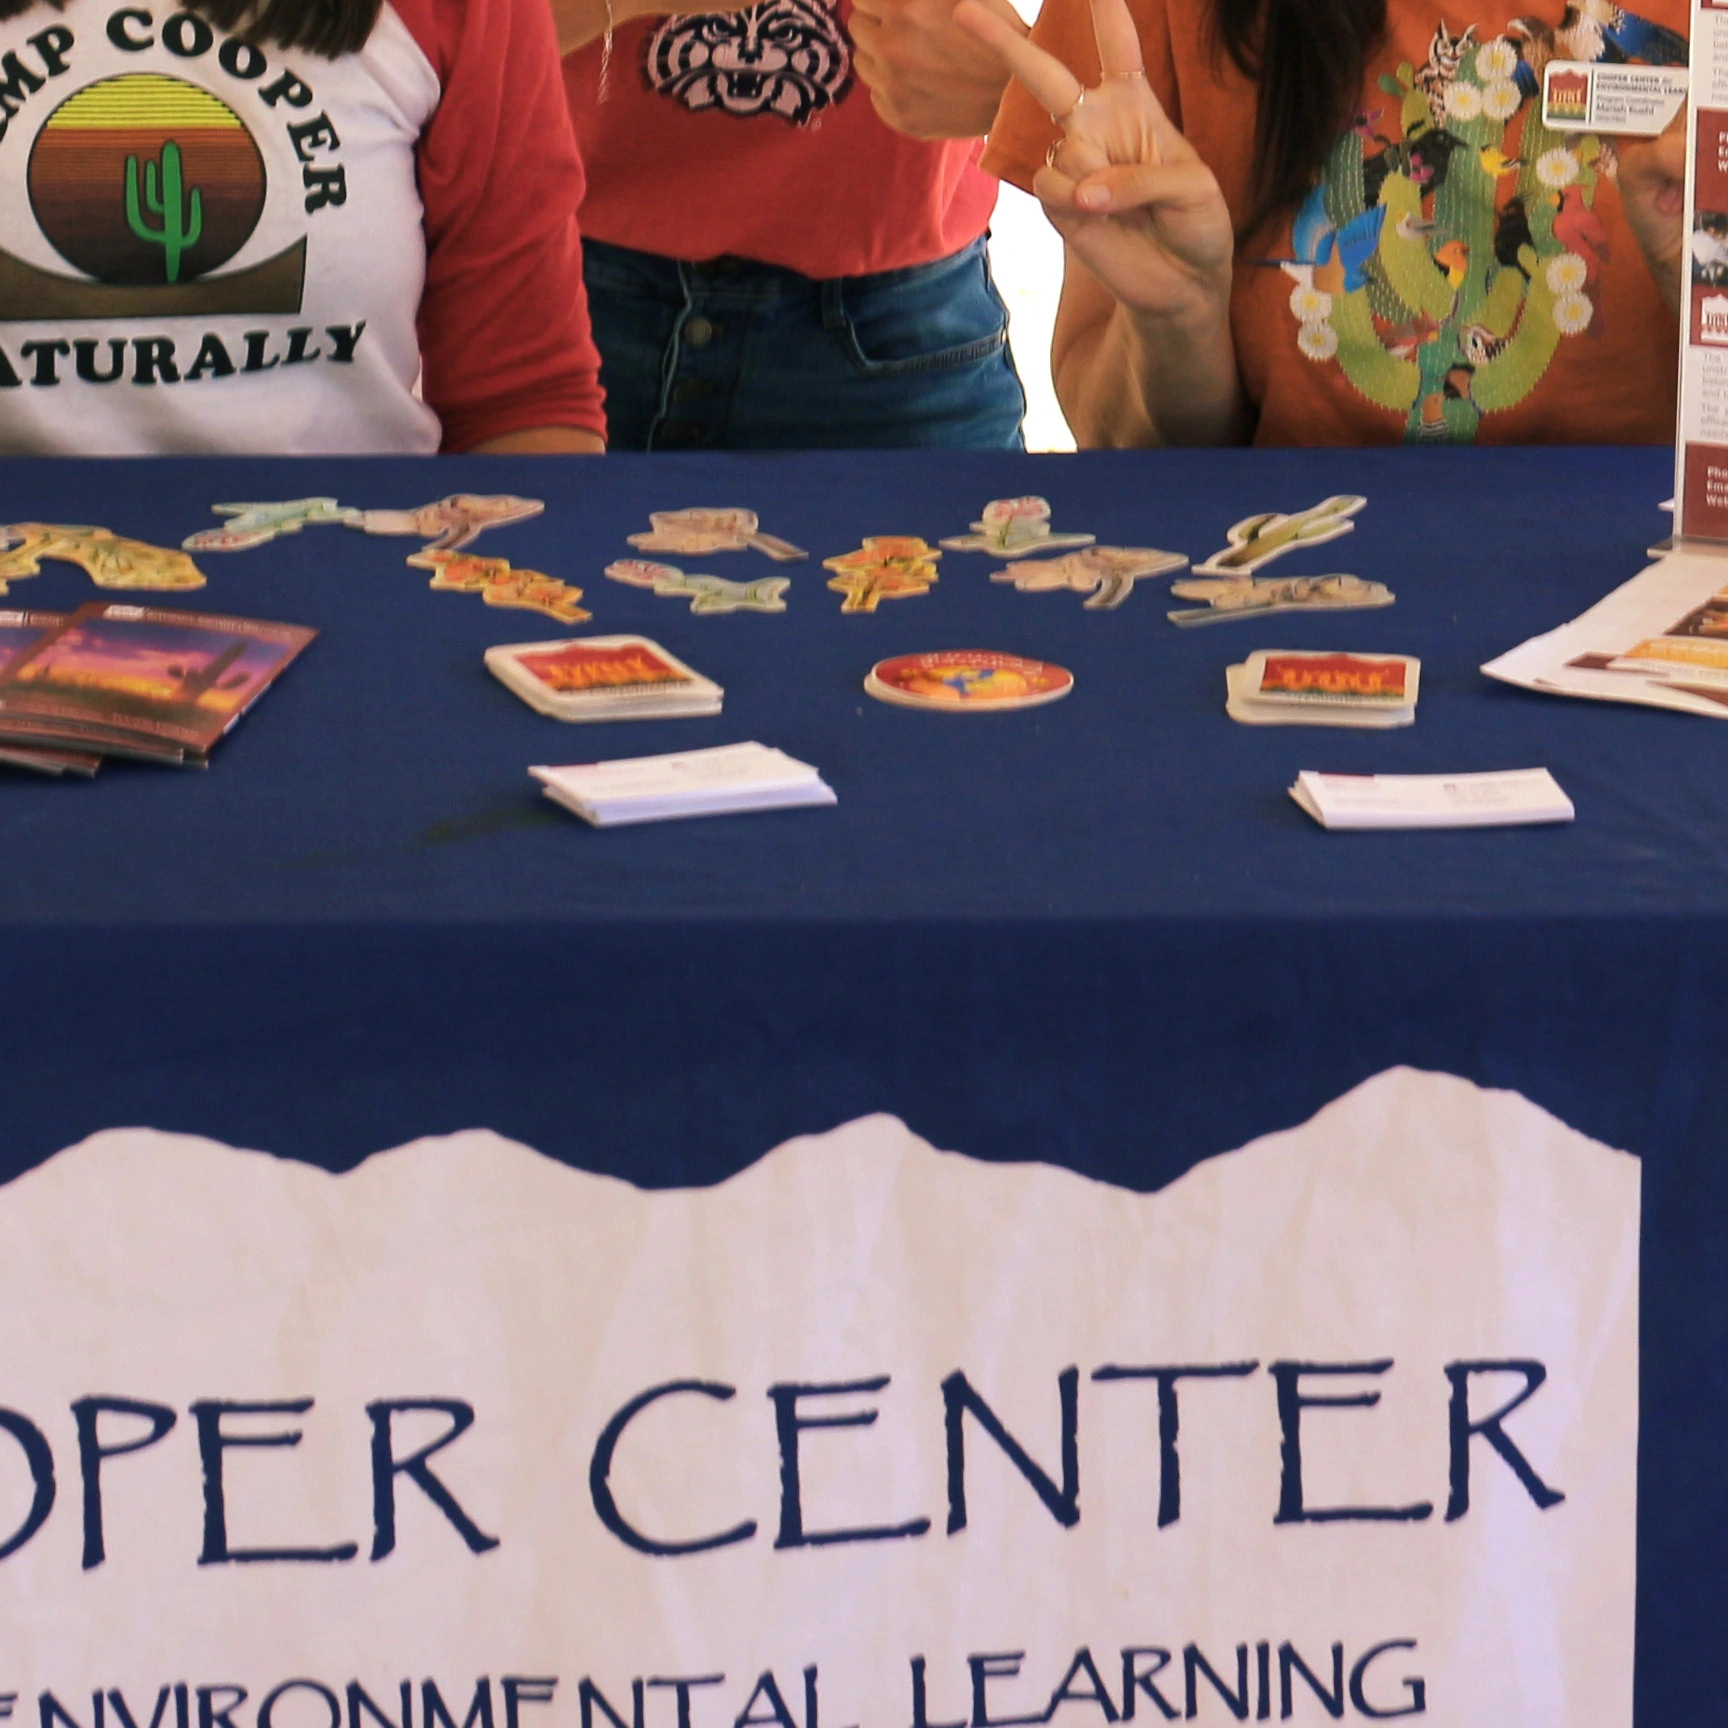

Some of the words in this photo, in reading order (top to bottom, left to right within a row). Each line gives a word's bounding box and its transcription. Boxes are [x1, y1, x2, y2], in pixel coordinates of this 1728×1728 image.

[105, 8, 347, 214] COOPER
[586, 1353, 1566, 1557] CENTER
[908, 1637, 1428, 1728] LEARNING
